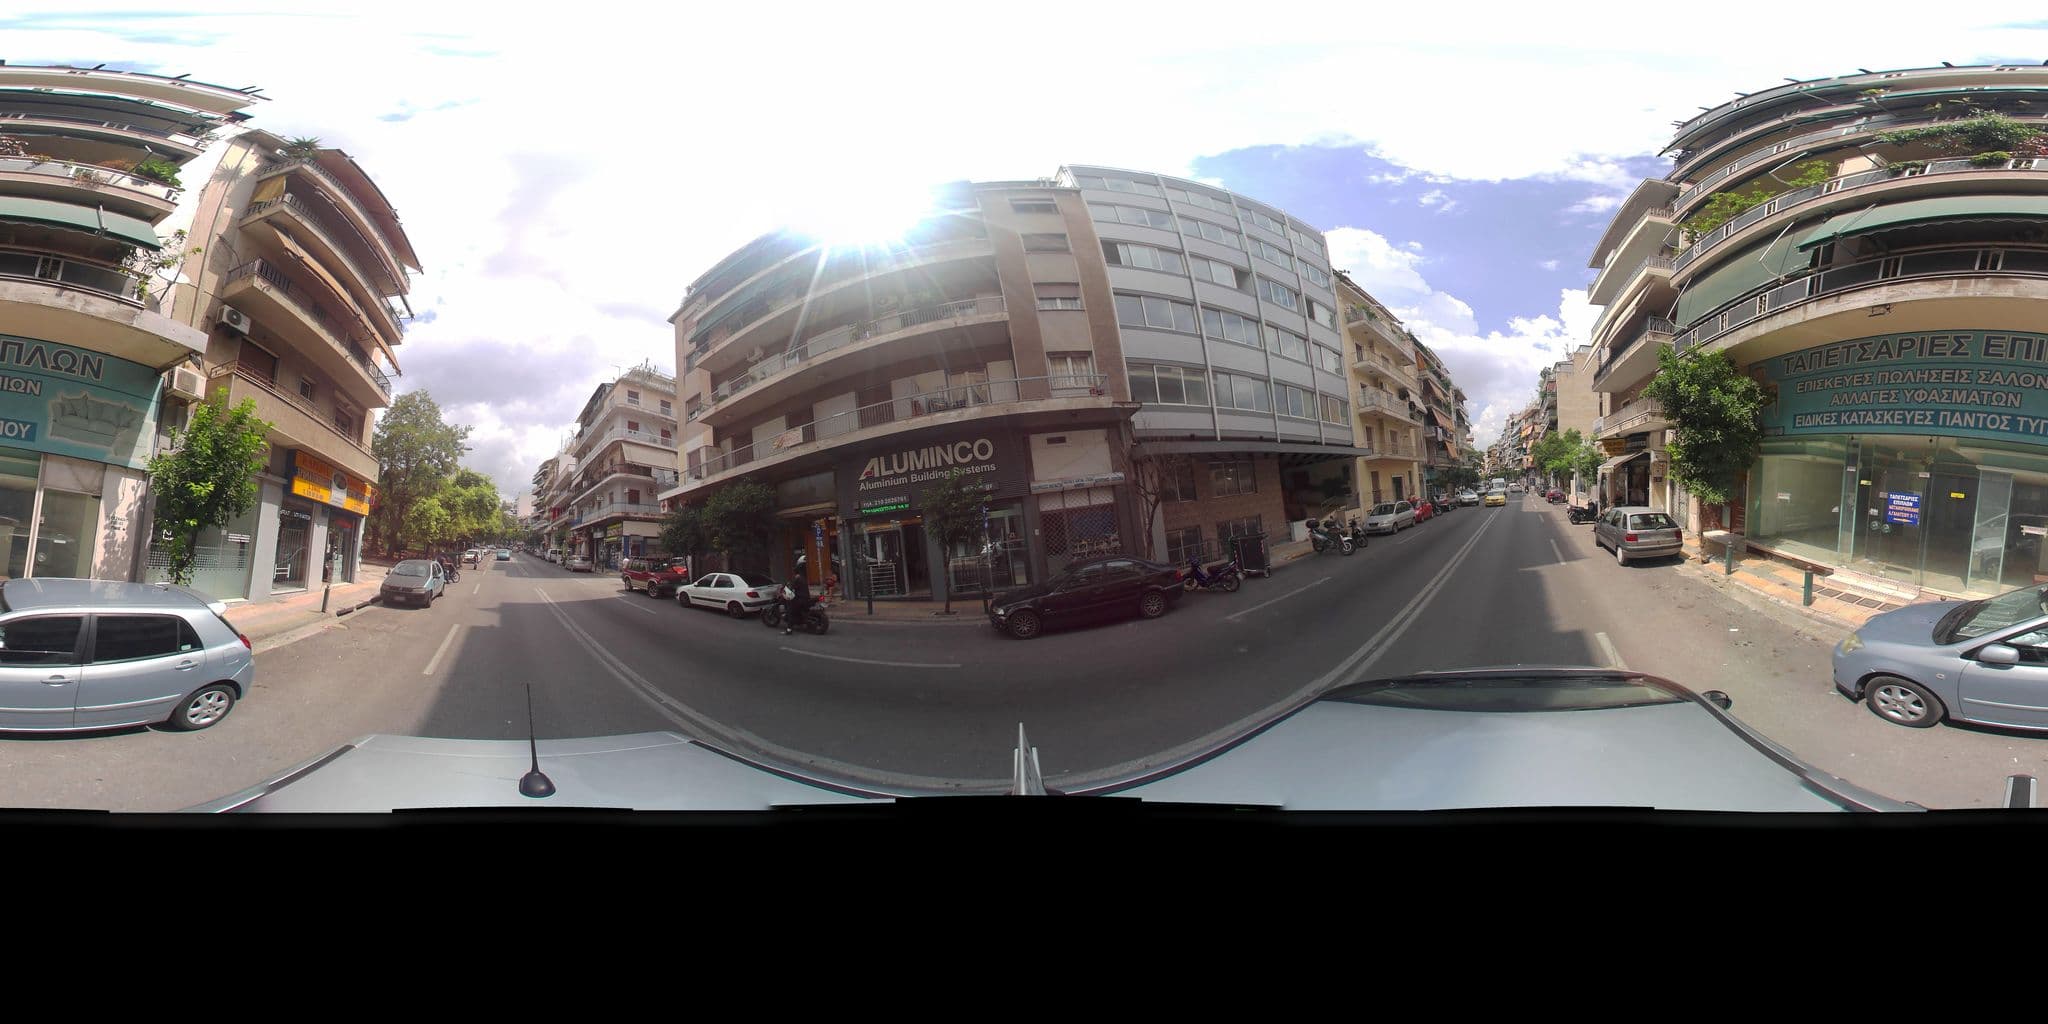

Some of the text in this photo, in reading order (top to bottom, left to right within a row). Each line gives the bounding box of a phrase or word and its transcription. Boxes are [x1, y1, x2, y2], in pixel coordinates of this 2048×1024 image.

[1783, 334, 1973, 376] ΤΑΠΕΤΣΑΡΙΕΣ
[0, 376, 42, 397] ΙΩΝ
[1796, 372, 1874, 394] ΕΠΙΣΚΕΥΕΣ
[1877, 368, 1972, 385] ΠΩΛΗΣΕΙΣ
[1830, 387, 2022, 408] ΑΛΛΑΓΕΣ ΥΦΑΣΜΑΤΩΝ
[1795, 412, 1838, 428] ΕΙΔΙΚΕΣ
[1840, 410, 1935, 425] ΚΑΤΑΣΚΕΥΕΣ
[1938, 411, 2012, 431] ΠΑΝΤΟΣ
[859, 438, 994, 480] ALUMINCO
[859, 463, 997, 491] Aluminium Building Systems
